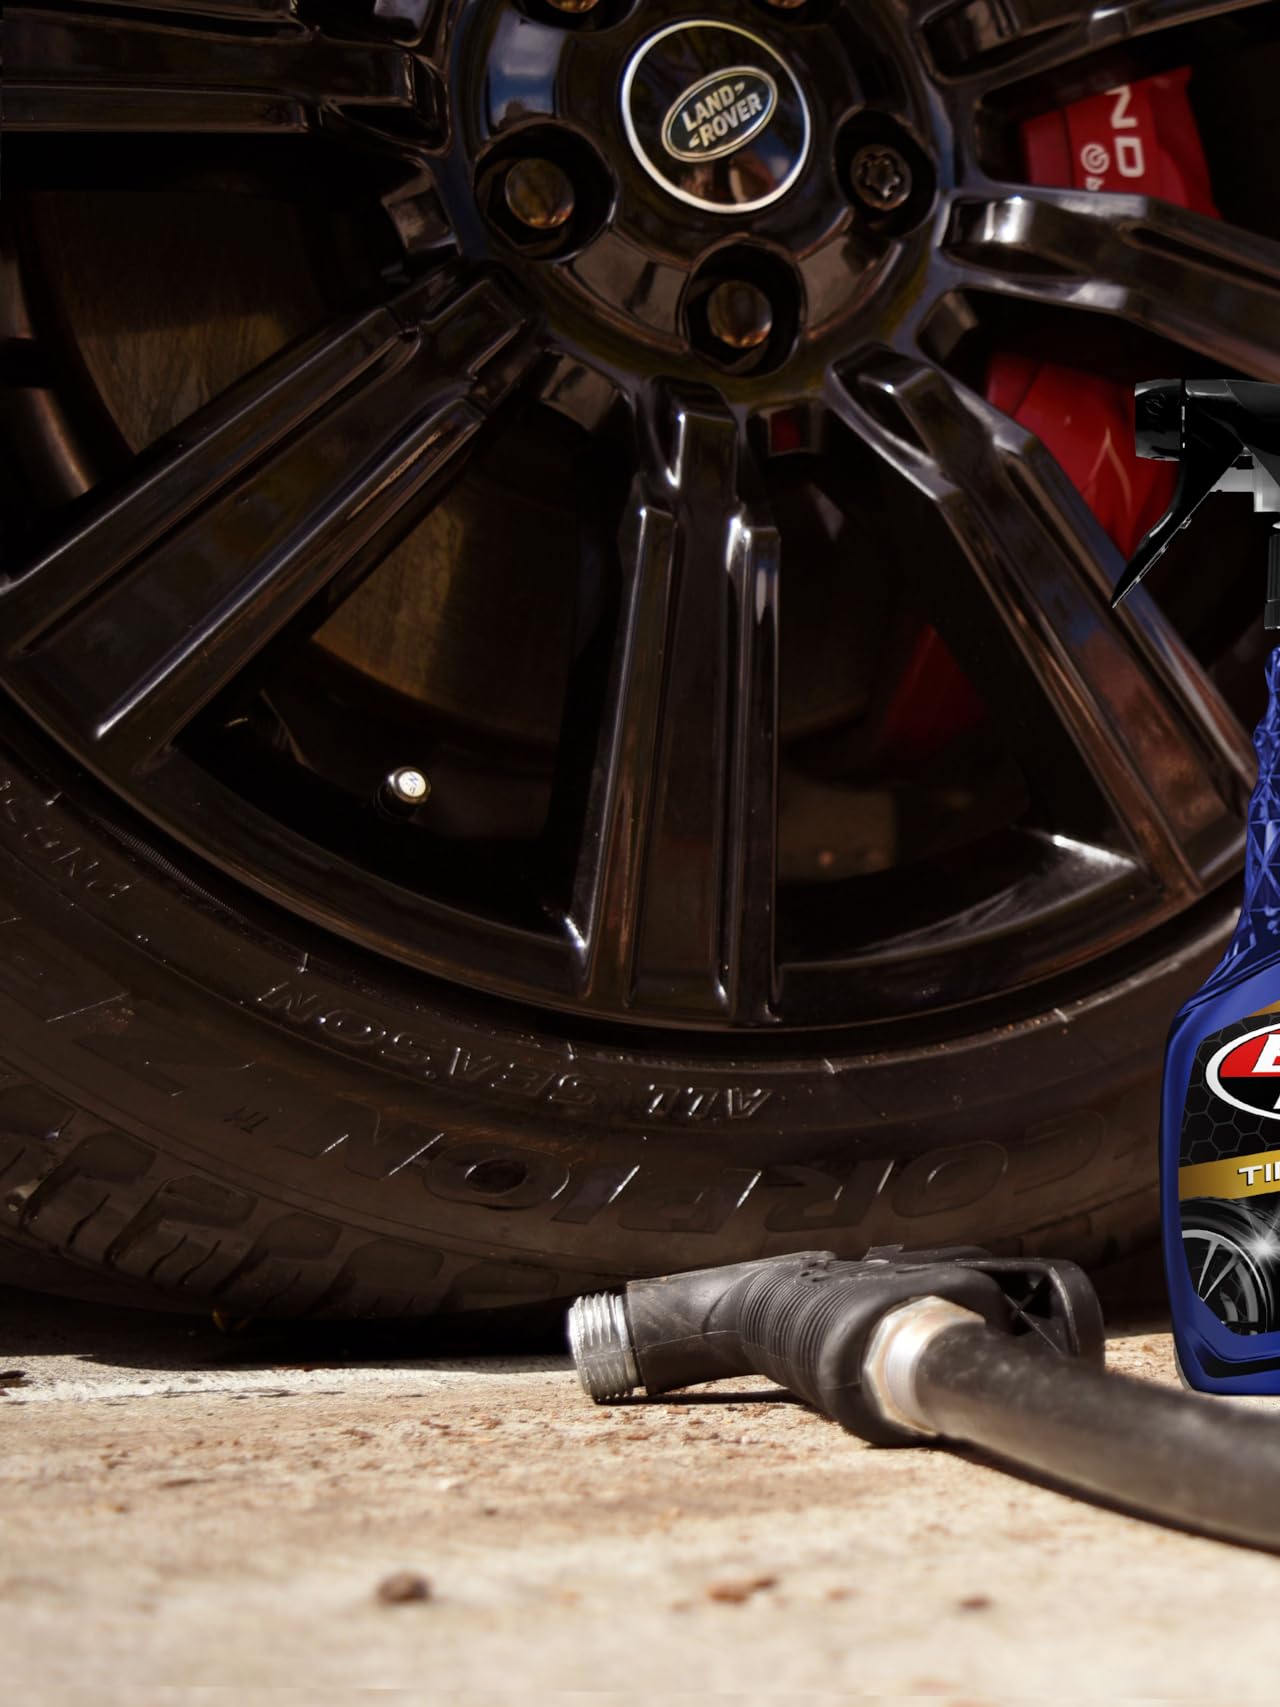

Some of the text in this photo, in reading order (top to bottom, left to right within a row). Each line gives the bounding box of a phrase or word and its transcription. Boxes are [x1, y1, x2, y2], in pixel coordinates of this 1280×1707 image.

[682, 83, 736, 132] LAND
[699, 92, 763, 147] ROVER
[257, 981, 599, 1104] SEASON
[647, 1082, 775, 1120] ALL
